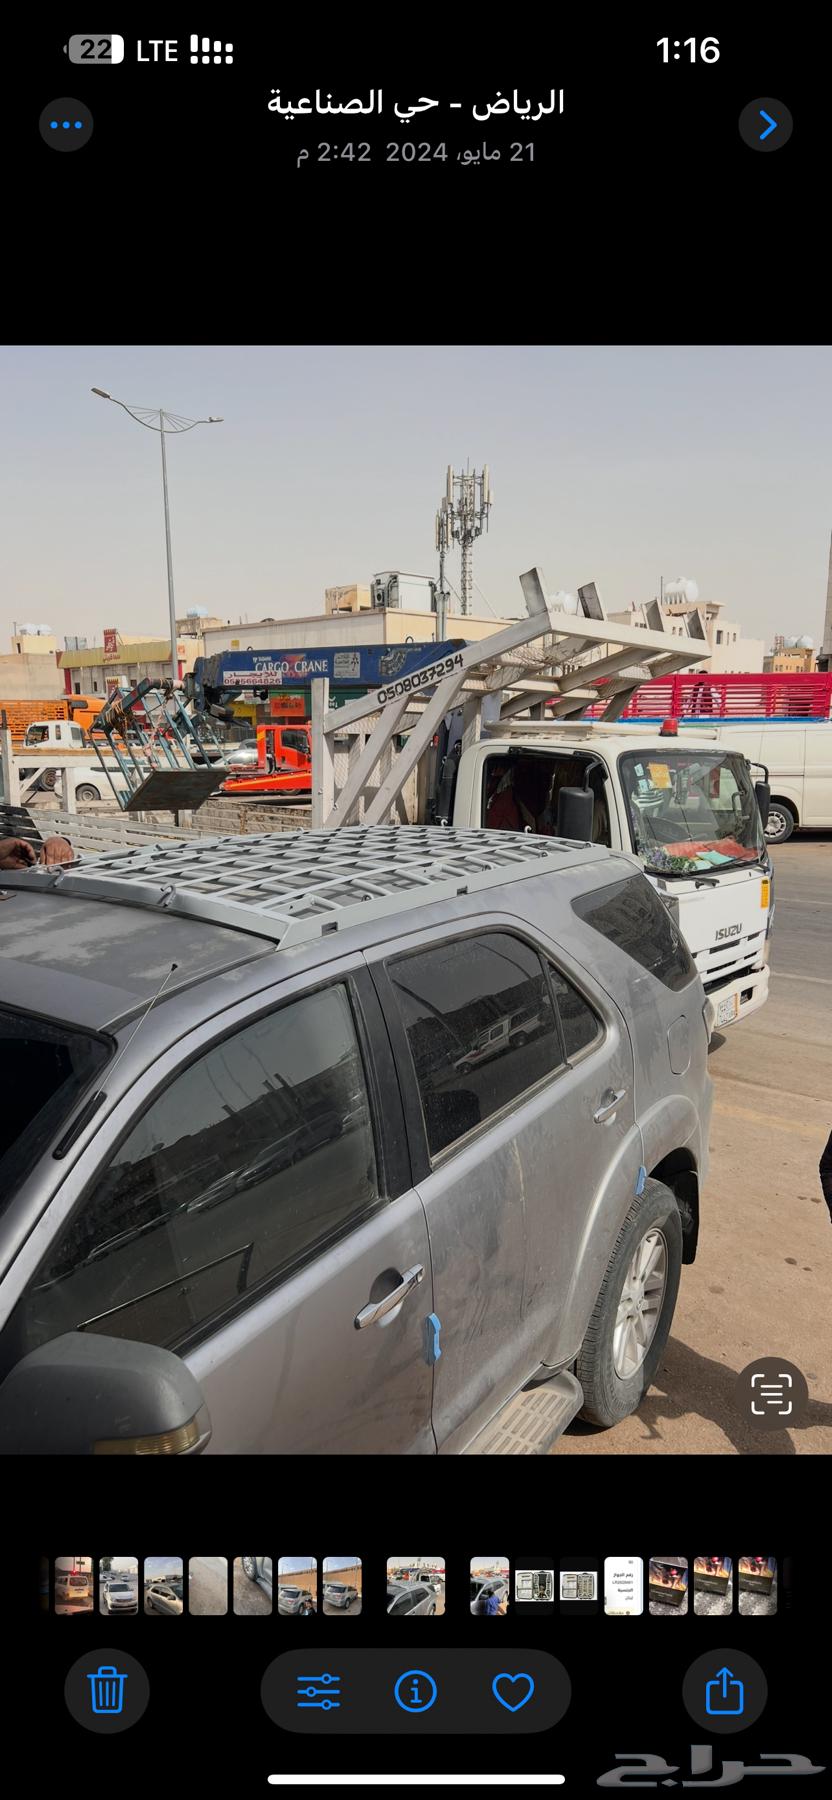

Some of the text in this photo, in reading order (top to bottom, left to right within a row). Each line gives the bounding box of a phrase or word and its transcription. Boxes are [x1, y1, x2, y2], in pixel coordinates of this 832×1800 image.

[255, 661, 289, 673] CARGO
[294, 660, 328, 672] CRANE
[377, 654, 463, 703] 0508037294
[715, 923, 742, 941] ISUZU
